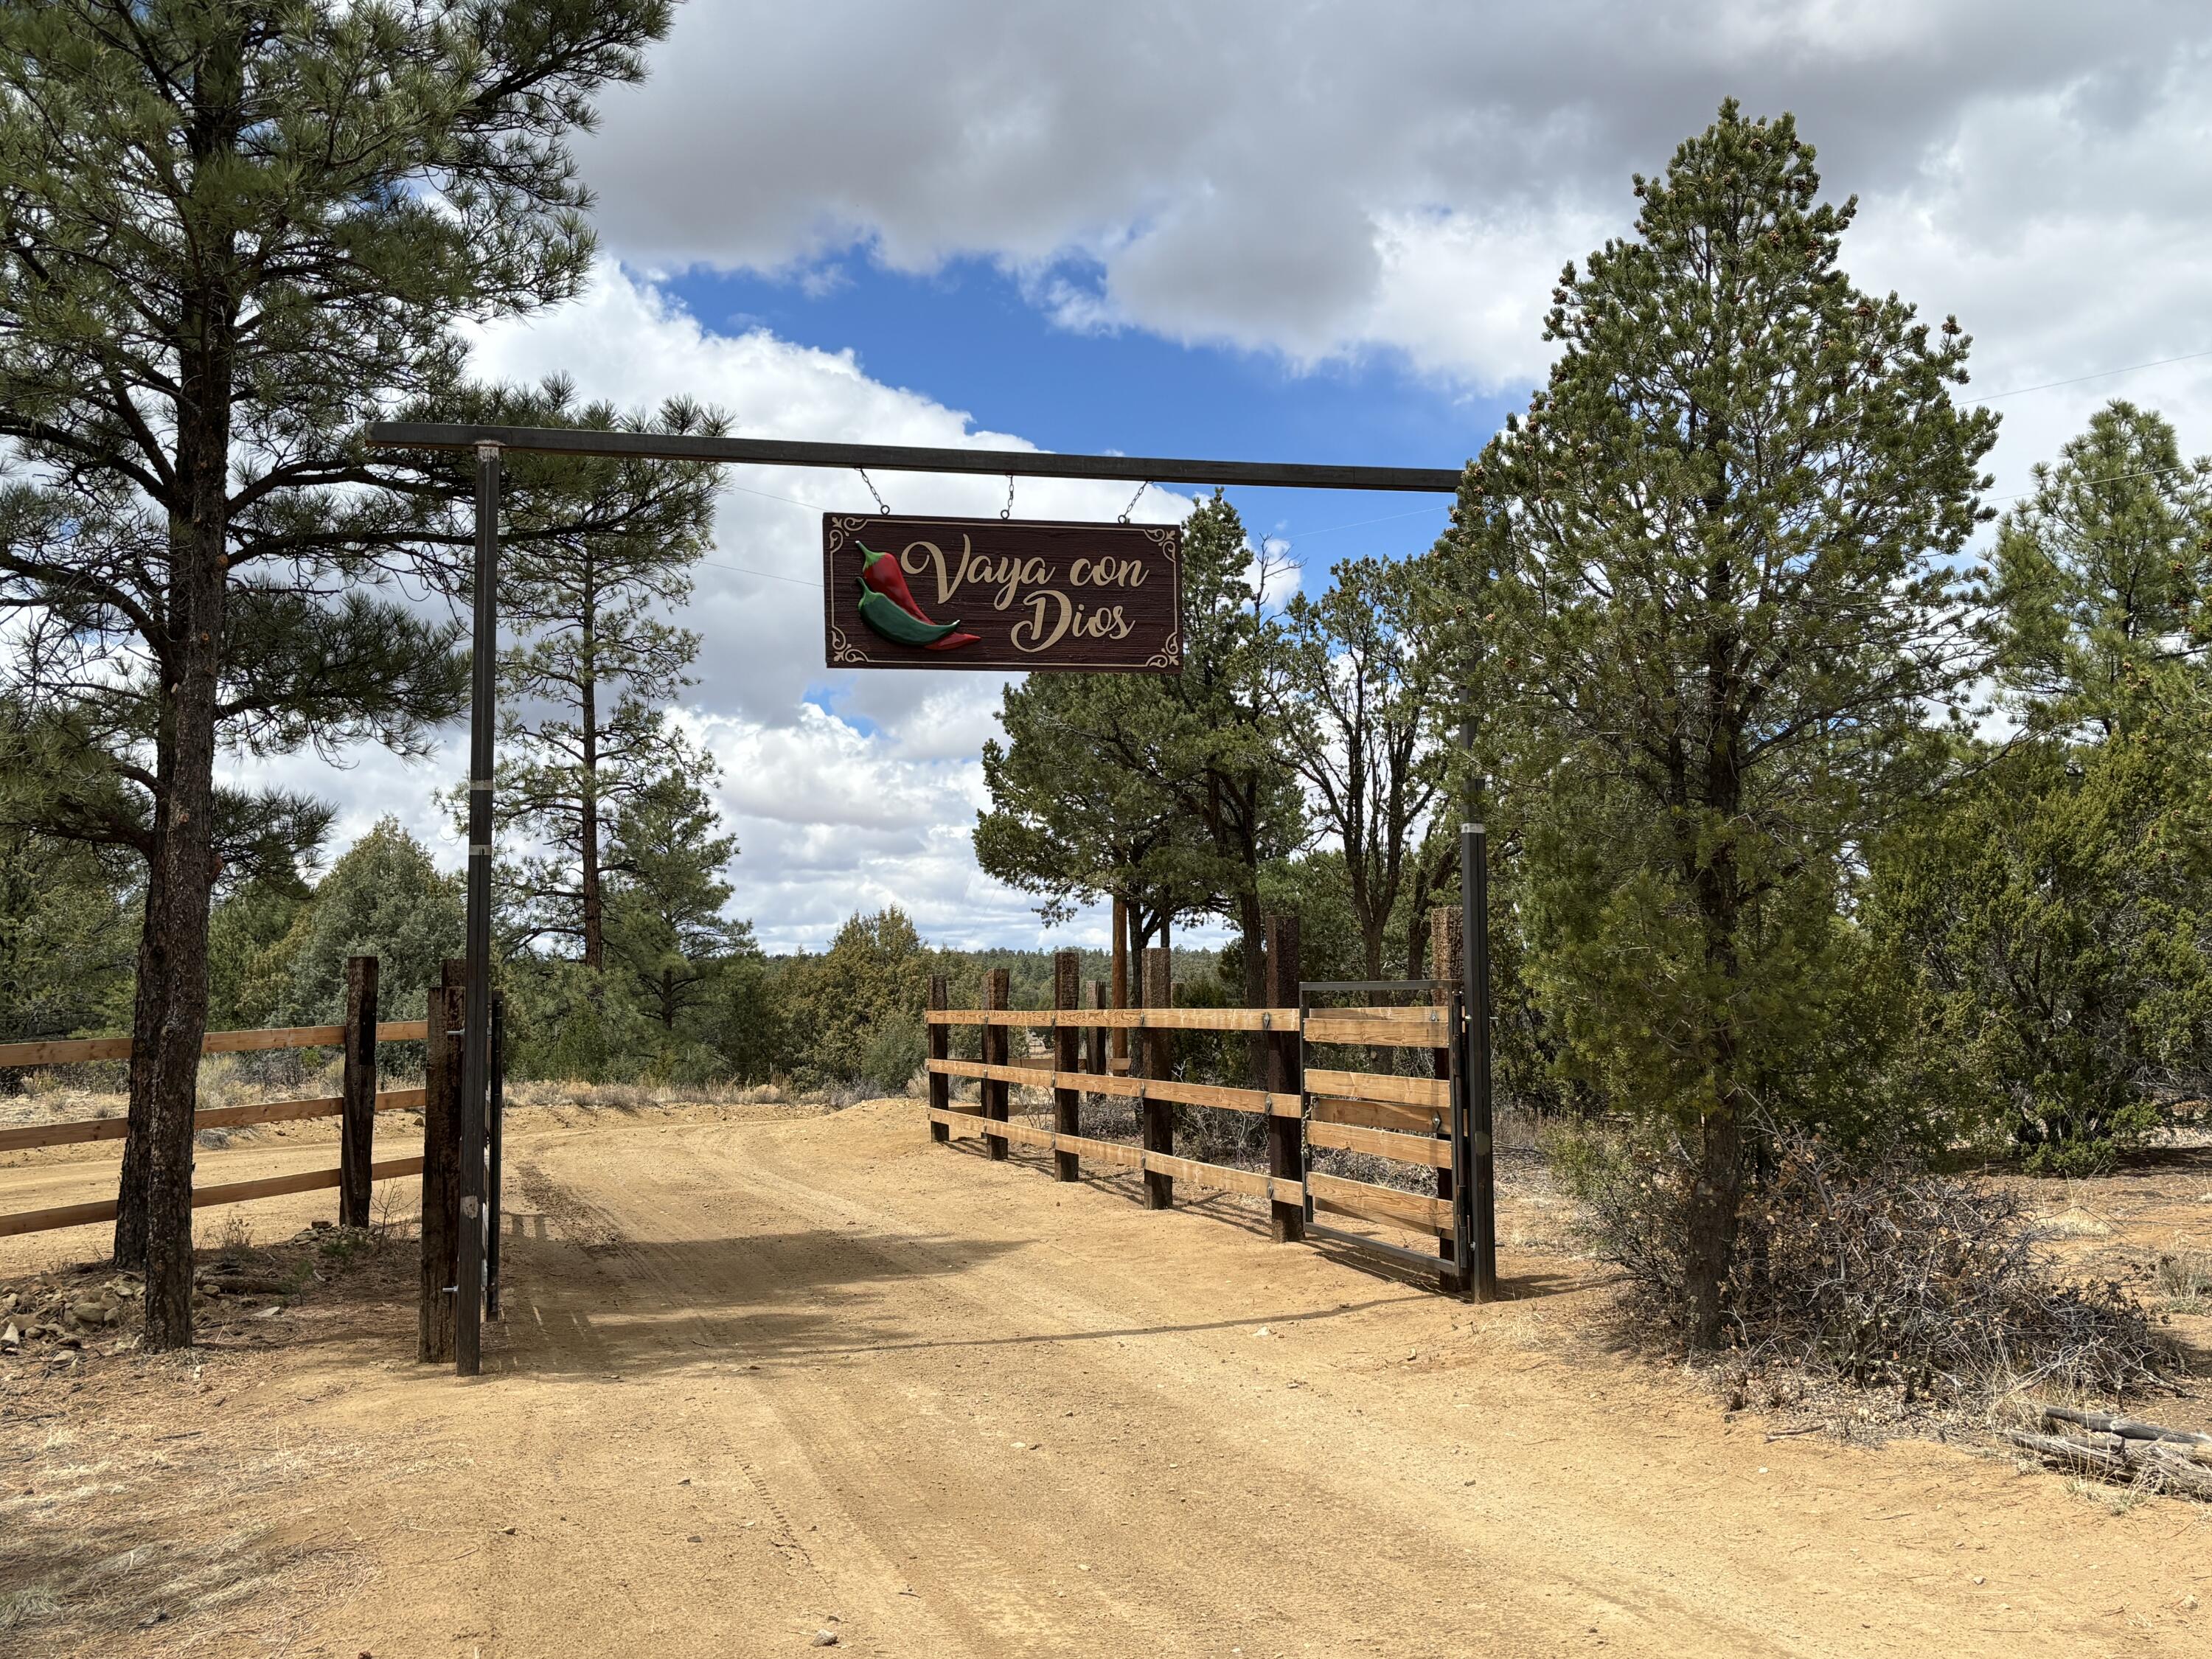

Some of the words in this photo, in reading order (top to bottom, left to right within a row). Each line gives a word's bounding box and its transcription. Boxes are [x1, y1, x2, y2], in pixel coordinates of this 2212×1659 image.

[900, 534, 1056, 611] Vaya
[1069, 556, 1149, 588] con
[1011, 590, 1135, 653] Dios
